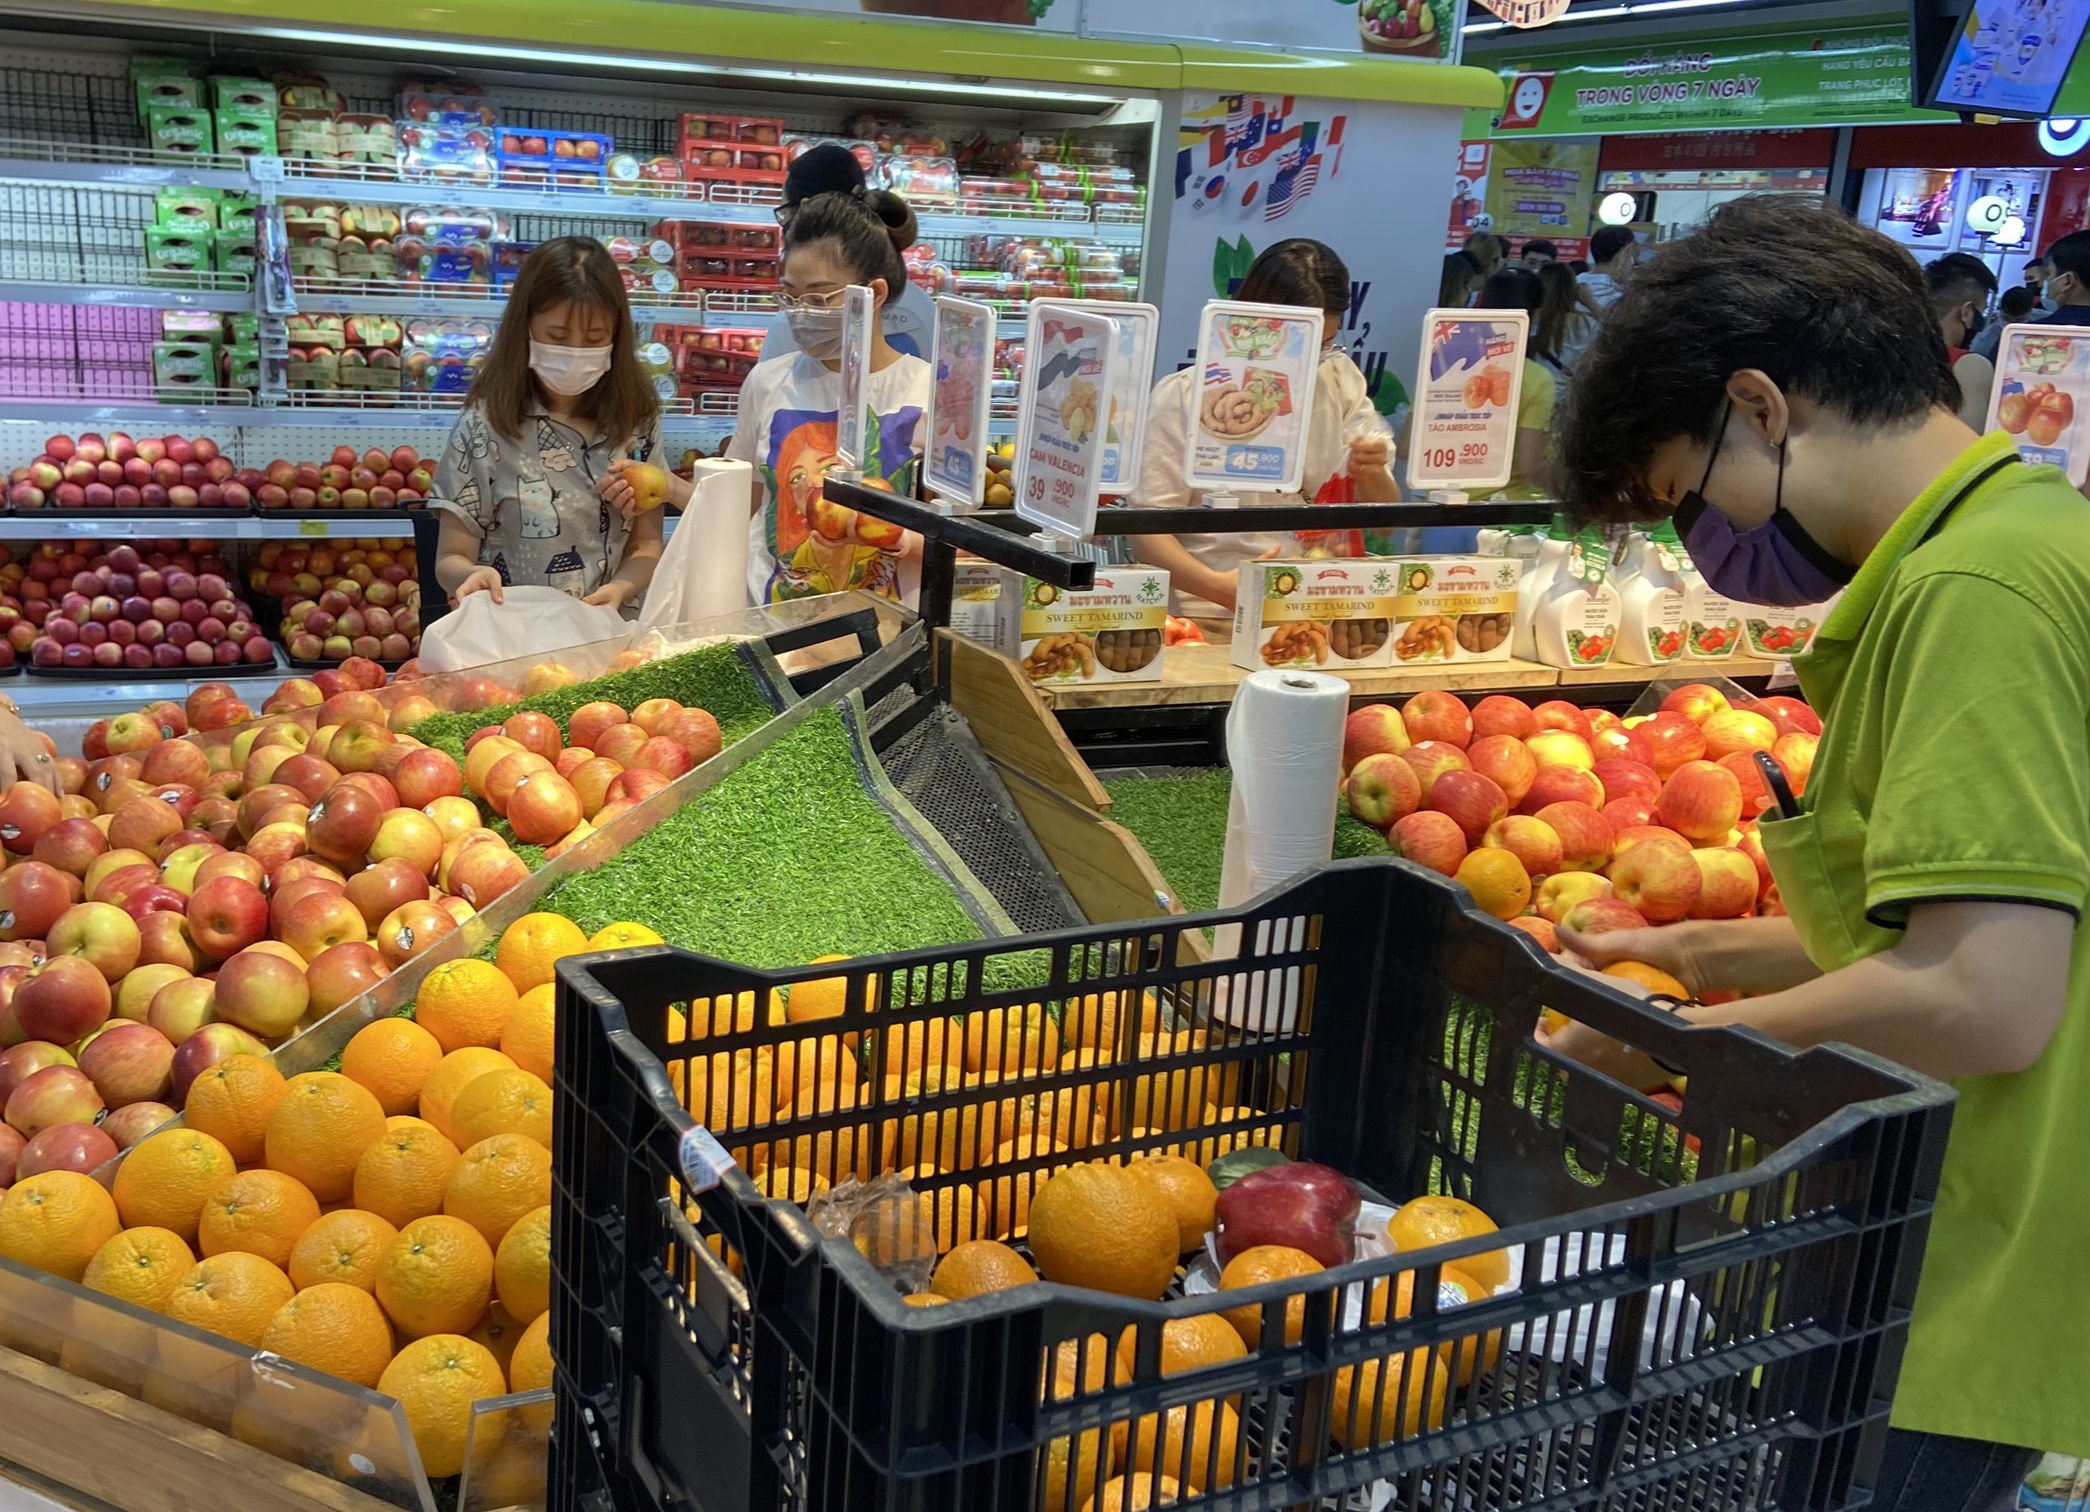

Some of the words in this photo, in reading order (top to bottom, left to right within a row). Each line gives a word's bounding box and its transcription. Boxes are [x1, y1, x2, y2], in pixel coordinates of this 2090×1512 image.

[1577, 85, 1633, 107] TRONG
[1639, 79, 1687, 103] VÒNG
[1692, 80, 1704, 100] 7
[1707, 74, 1761, 98] NGÀY
[158, 128, 204, 141] Organic
[223, 129, 269, 142] Organic
[156, 247, 201, 260] Organic
[162, 359, 206, 371] Organic
[1446, 423, 1487, 431] AMBROSIA
[1231, 452, 1258, 471] 45
[1423, 449, 1456, 467] 109
[1460, 443, 1488, 456] .900
[2022, 453, 2043, 467] 39
[1030, 447, 1046, 462] CAM
[1047, 453, 1085, 478] VALENCIA
[1029, 475, 1045, 500] 39
[1052, 478, 1075, 498] .900
[1135, 591, 1165, 604] NATCHA
[1306, 585, 1365, 597] มะขามหวาน
[1069, 594, 1132, 607] มะขามหวาน
[1284, 602, 1319, 611] SWEET
[1323, 601, 1375, 611] TAMARIND
[1417, 598, 1450, 607] SWEET
[1451, 596, 1499, 606] TAMARIND
[1046, 612, 1082, 623] SWEET
[1087, 611, 1143, 622] TAMARIND
